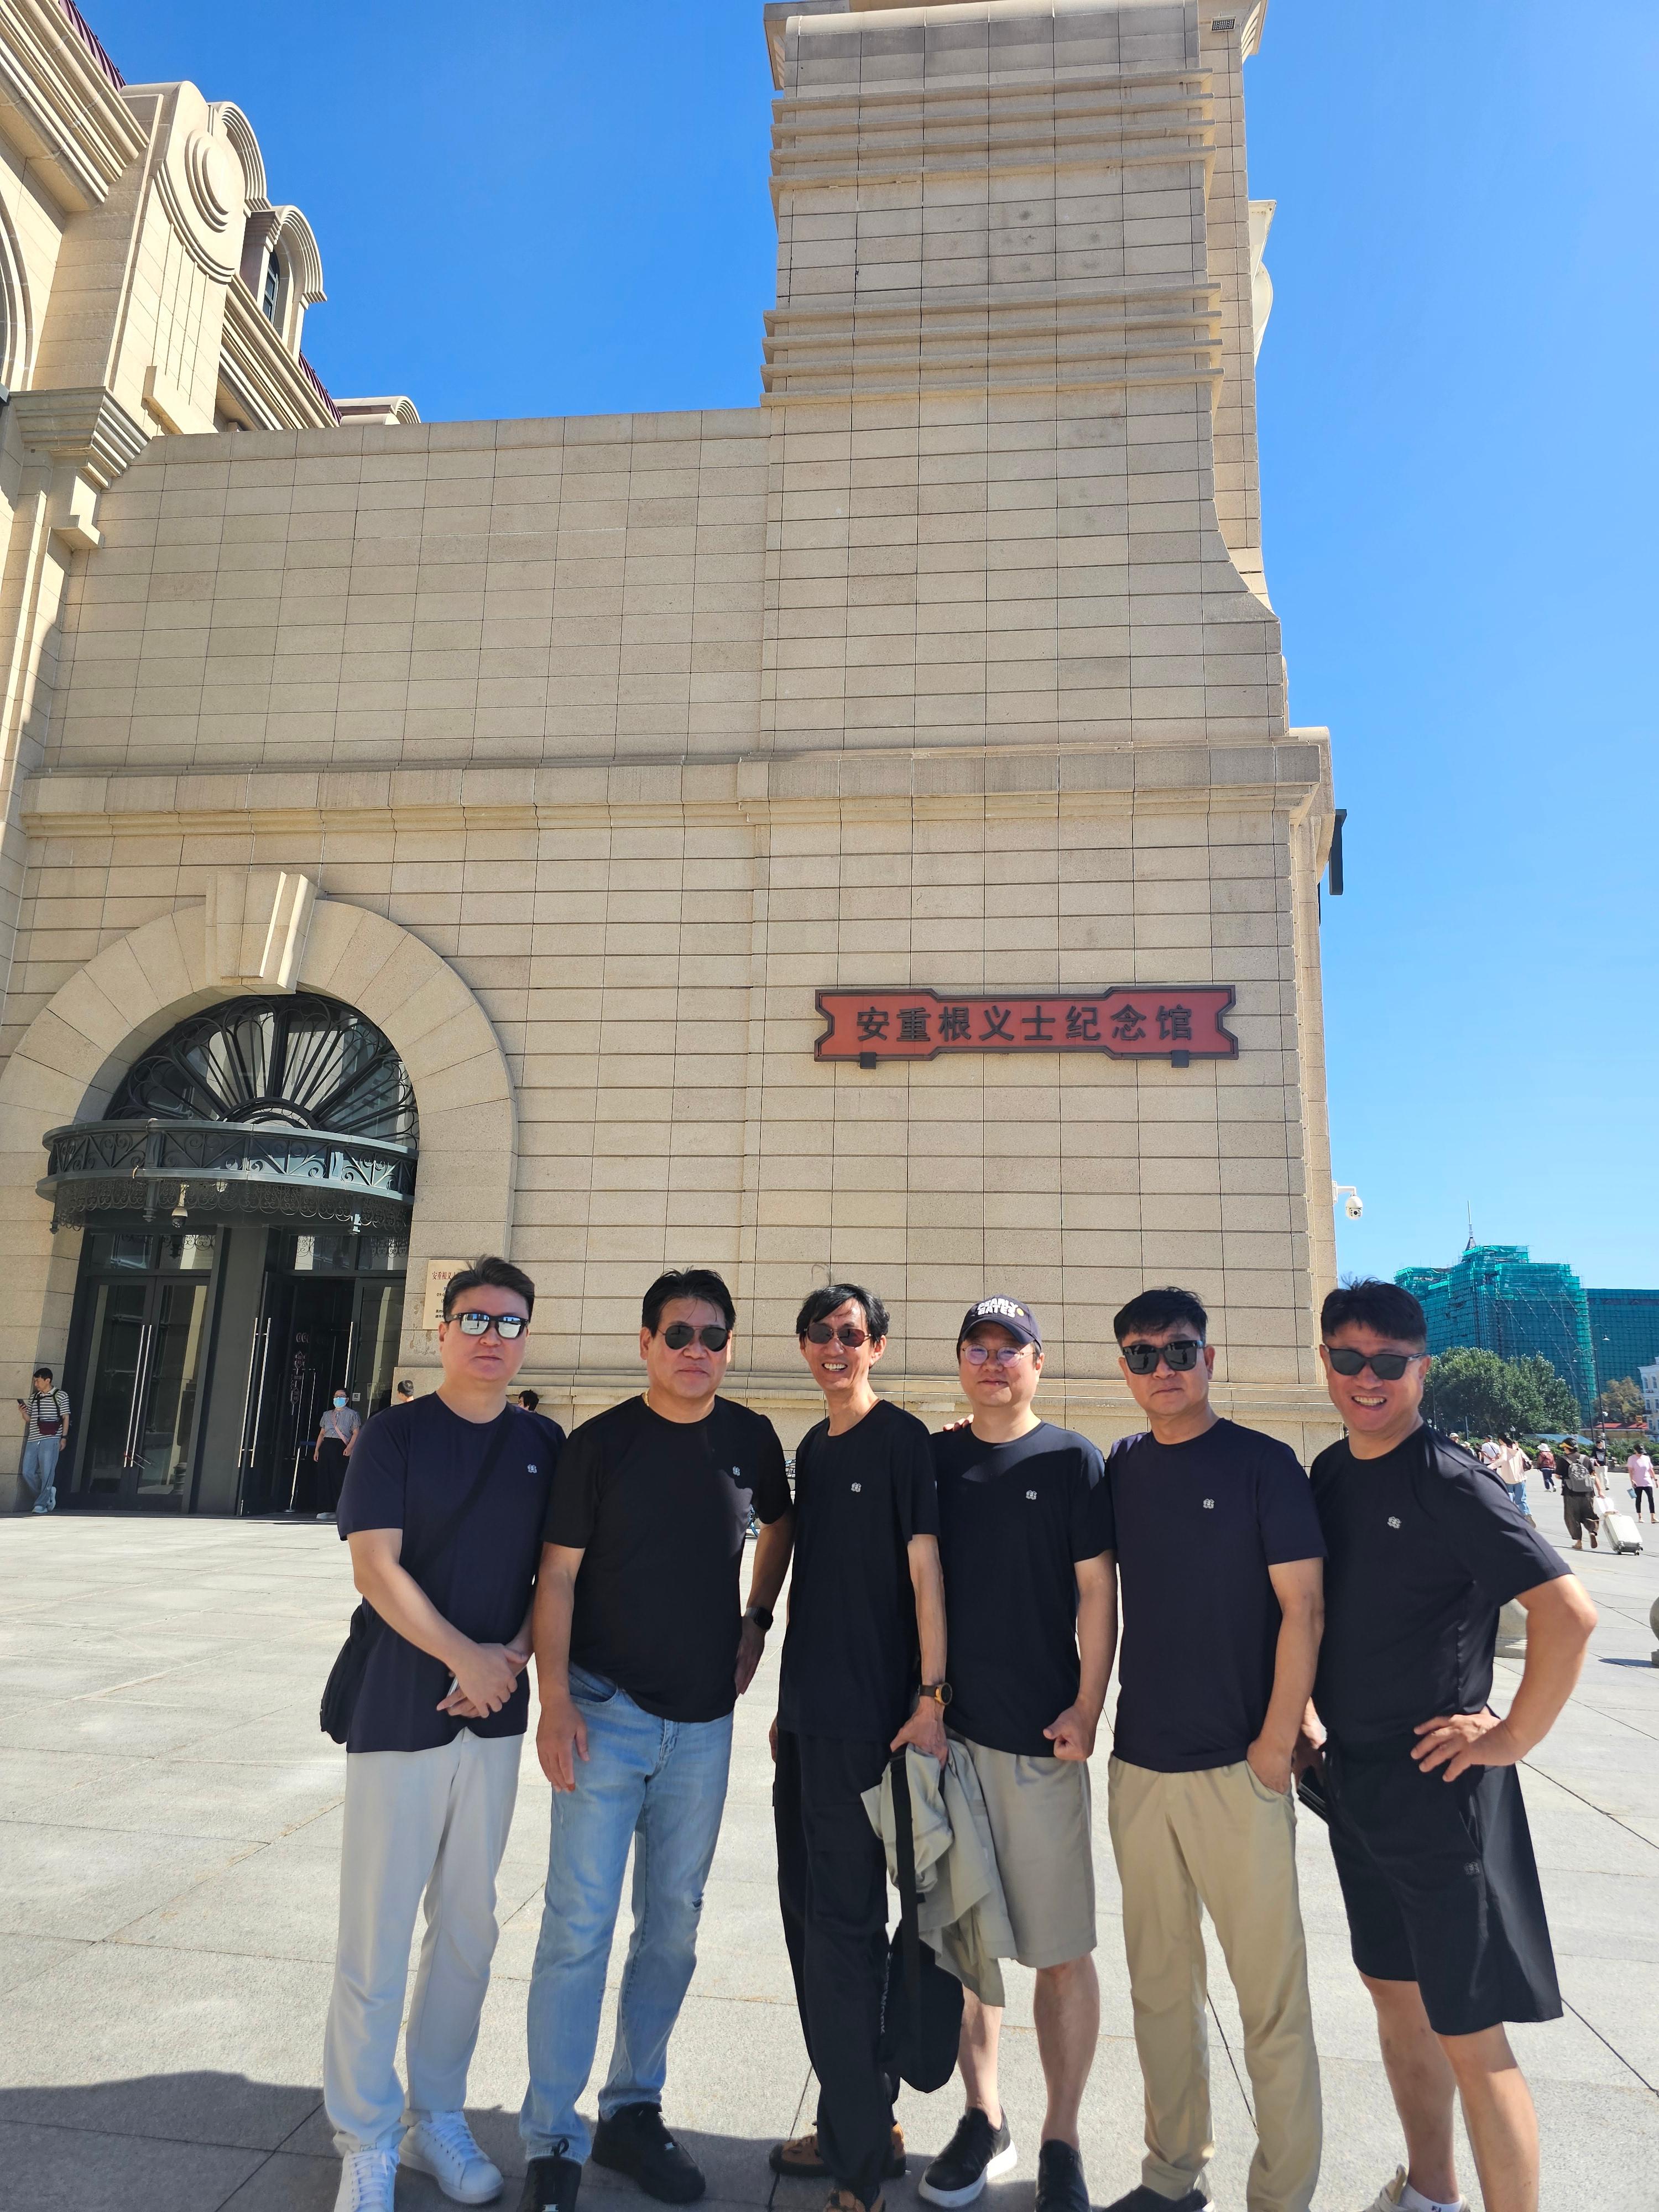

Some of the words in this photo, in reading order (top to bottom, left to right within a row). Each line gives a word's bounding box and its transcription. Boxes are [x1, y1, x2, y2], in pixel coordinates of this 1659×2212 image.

[856, 1004, 1192, 1042] 安重根义士纪念馆
